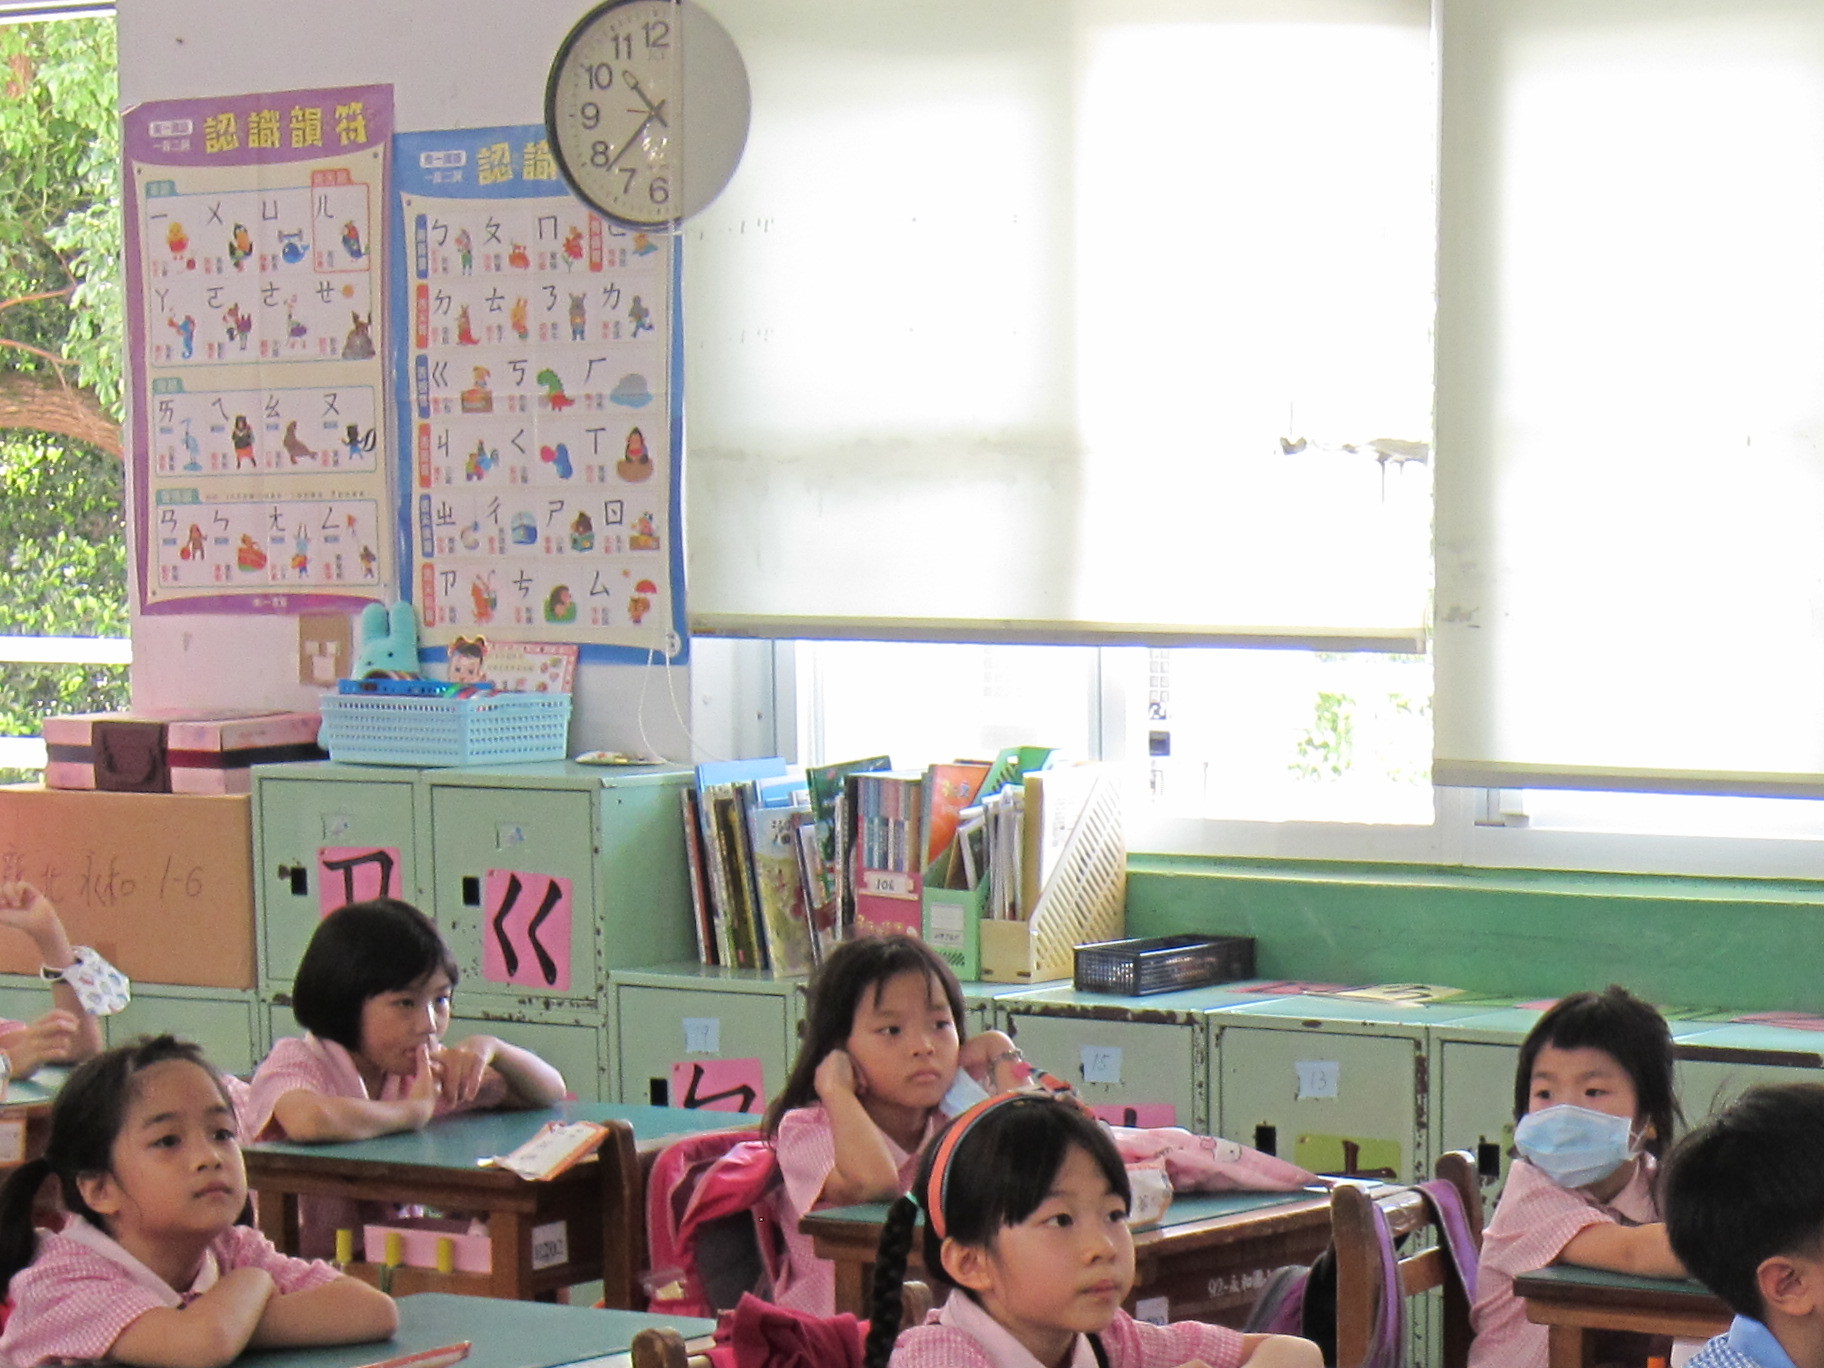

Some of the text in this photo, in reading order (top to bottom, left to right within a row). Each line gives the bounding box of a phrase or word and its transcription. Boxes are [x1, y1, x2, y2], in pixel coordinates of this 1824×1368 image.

[612, 33, 632, 60] 11
[642, 21, 668, 48] 12
[581, 63, 613, 90] 10
[204, 101, 368, 154] 認識韻符
[581, 102, 600, 129] 9
[591, 140, 609, 167] 8
[619, 168, 636, 194] 7
[649, 177, 669, 204] 6
